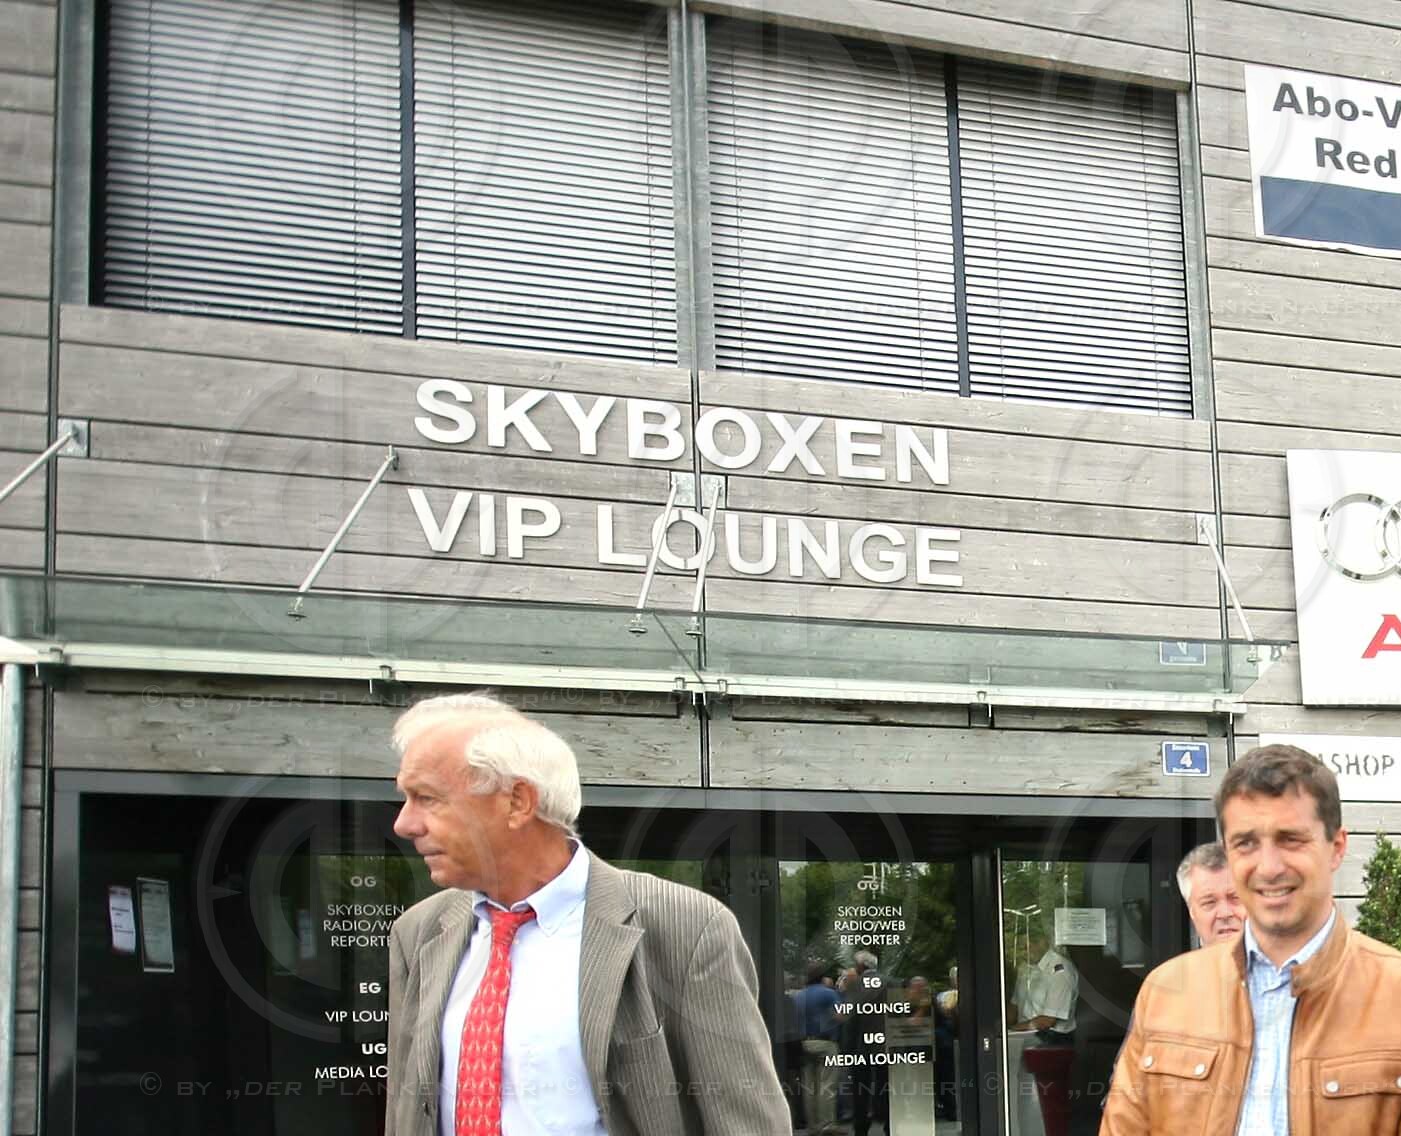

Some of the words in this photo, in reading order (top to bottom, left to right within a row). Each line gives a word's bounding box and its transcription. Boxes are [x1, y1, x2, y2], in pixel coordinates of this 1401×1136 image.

[1315, 136, 1398, 180] Red
[413, 378, 952, 487] SKYBOXEN
[407, 488, 562, 560] VIP
[597, 502, 965, 588] LOUNGE
[1180, 751, 1192, 768] 4
[350, 876, 376, 888] OG
[857, 880, 879, 891] OG
[327, 904, 404, 916] SKYBOXEN
[838, 906, 902, 917] SKYBOXEN
[834, 919, 906, 932] RADIO/WEB
[840, 934, 900, 946] REPORTER
[359, 982, 382, 994] EG
[863, 977, 882, 989] EG
[834, 1003, 853, 1015] VIP
[856, 1002, 911, 1015] LOUNGE
[325, 1010, 348, 1023] VIP
[863, 1032, 886, 1045] UG
[361, 1043, 387, 1055] UG
[824, 1054, 867, 1067] MEDIA
[870, 1051, 926, 1065] LOUNGE
[315, 1066, 365, 1079] MEDIA
